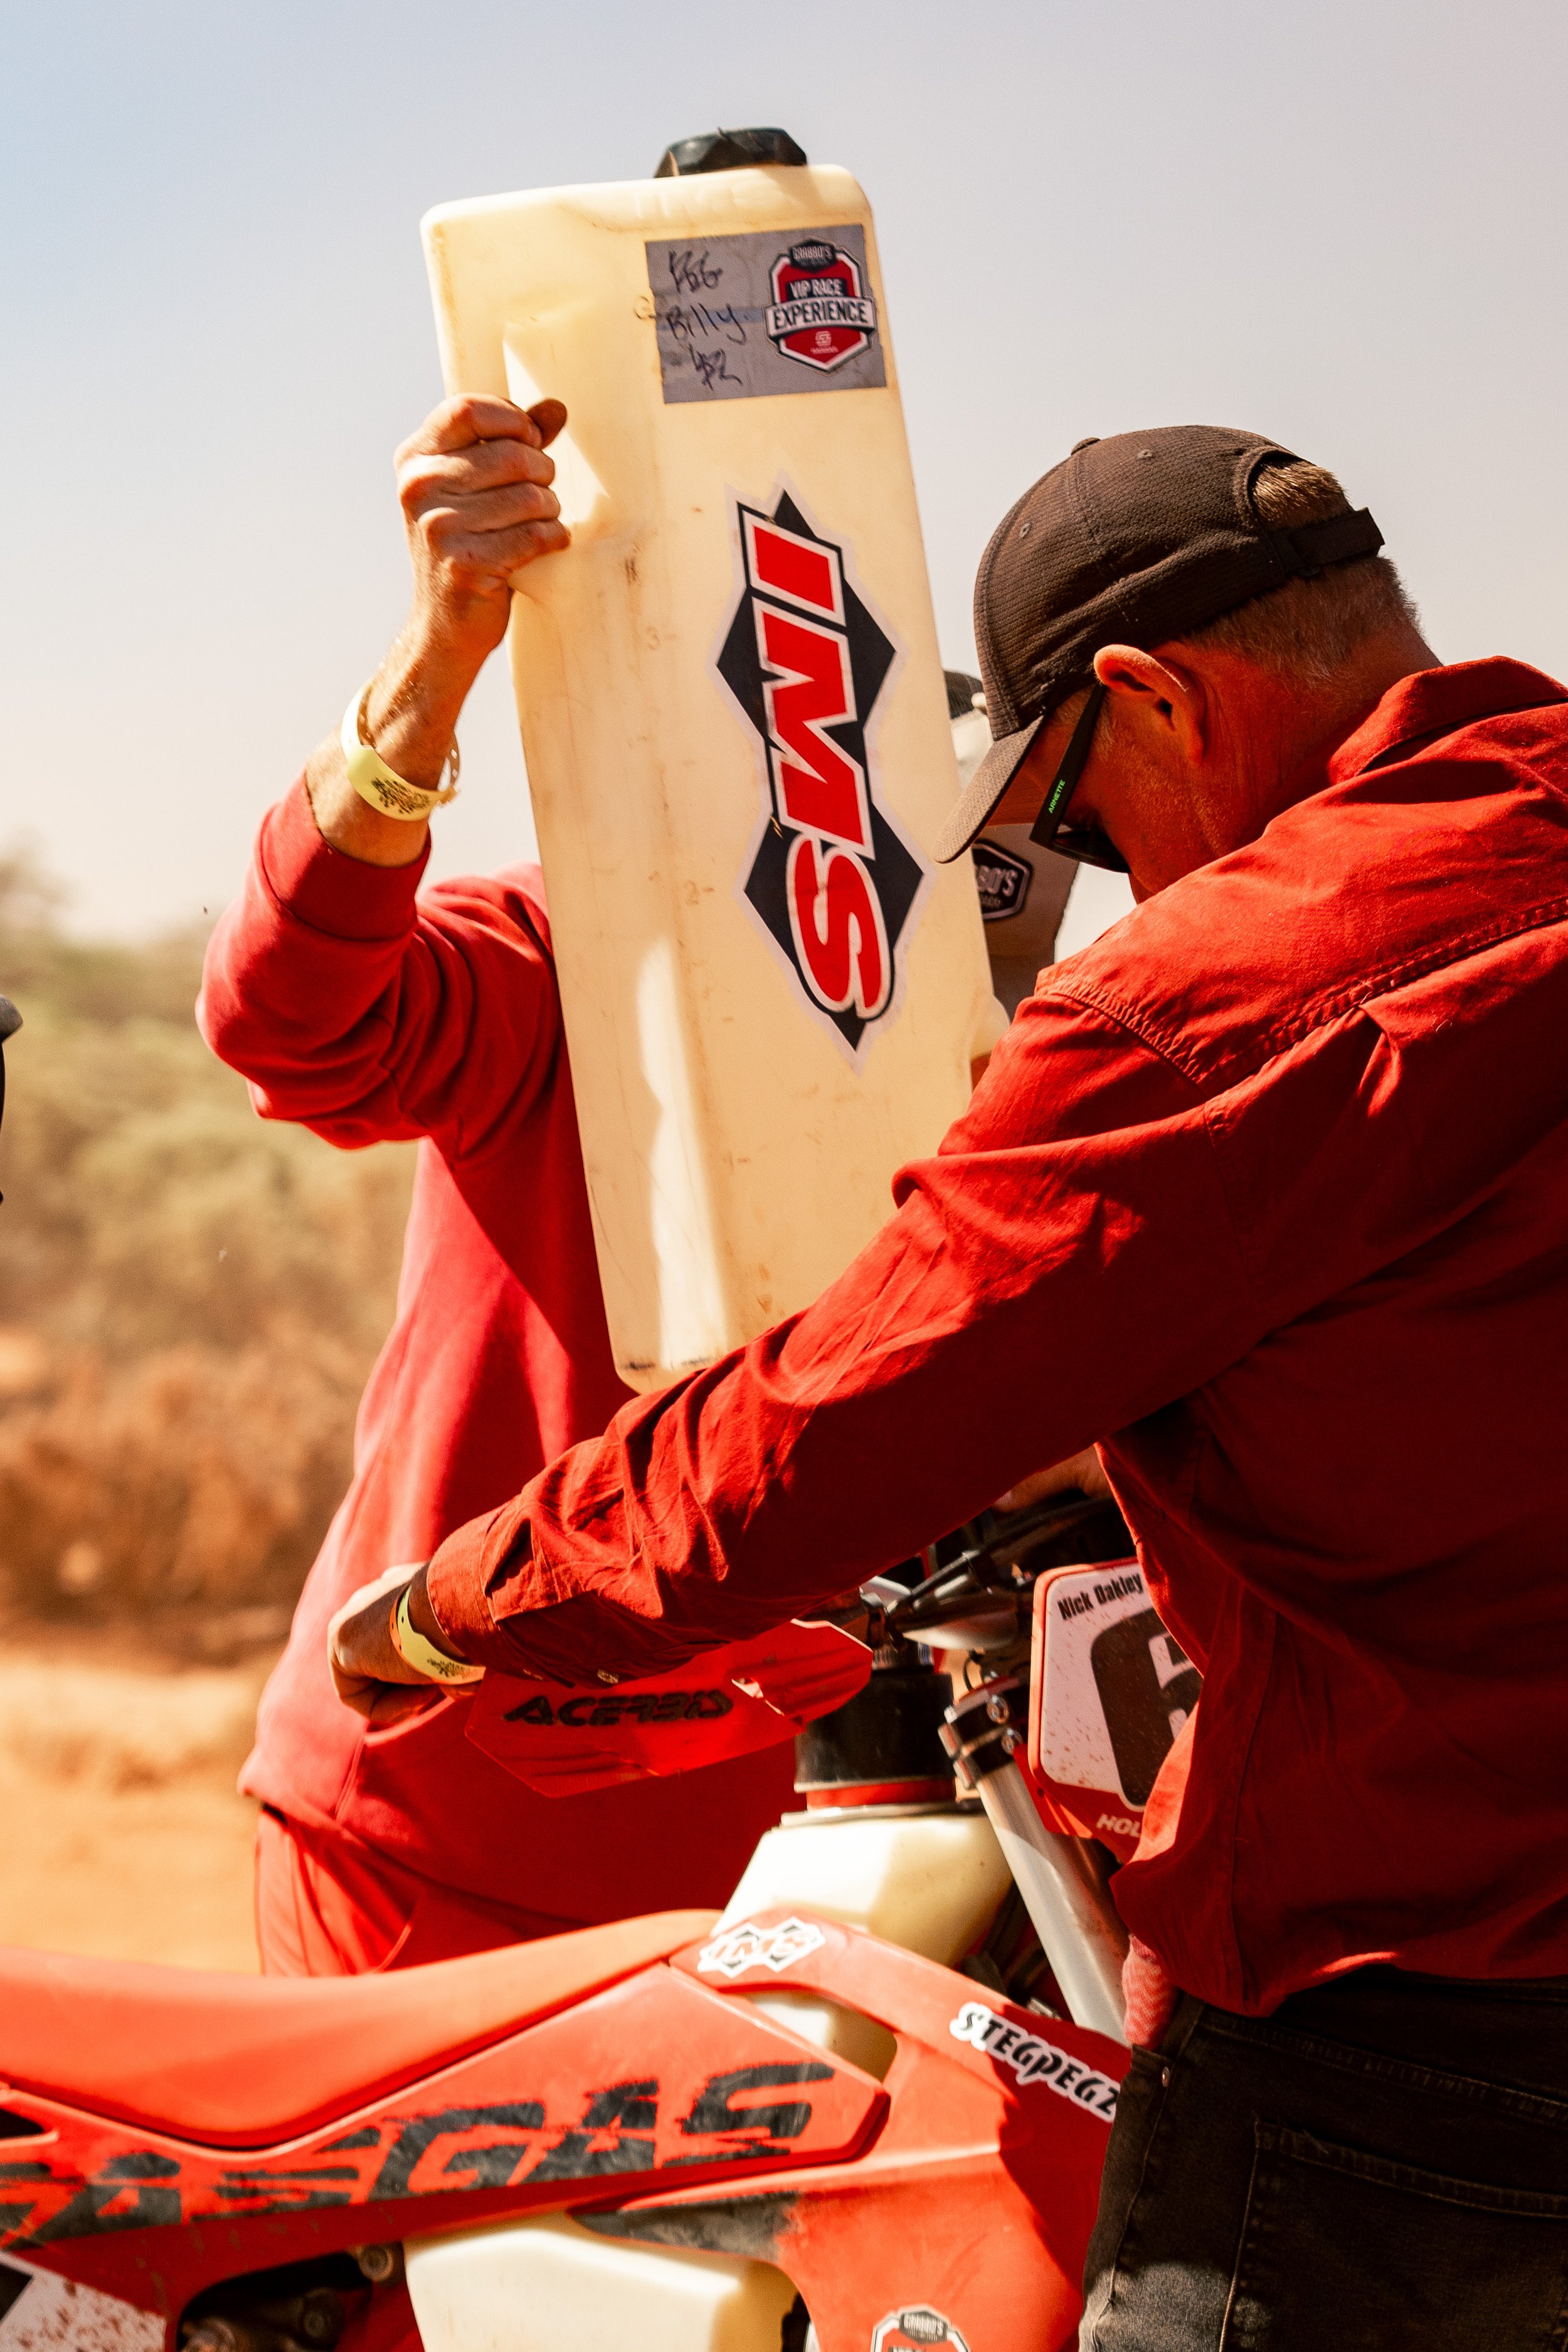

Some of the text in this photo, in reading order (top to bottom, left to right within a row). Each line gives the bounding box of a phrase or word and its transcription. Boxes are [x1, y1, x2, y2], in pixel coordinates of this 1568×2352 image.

[789, 278, 844, 299] VIP RACE
[773, 300, 868, 330] EXPERIENCE
[742, 509, 891, 1020] IMS
[1048, 780, 1066, 813] ARNETTE
[1057, 1573, 1143, 1620] Nick Oakley
